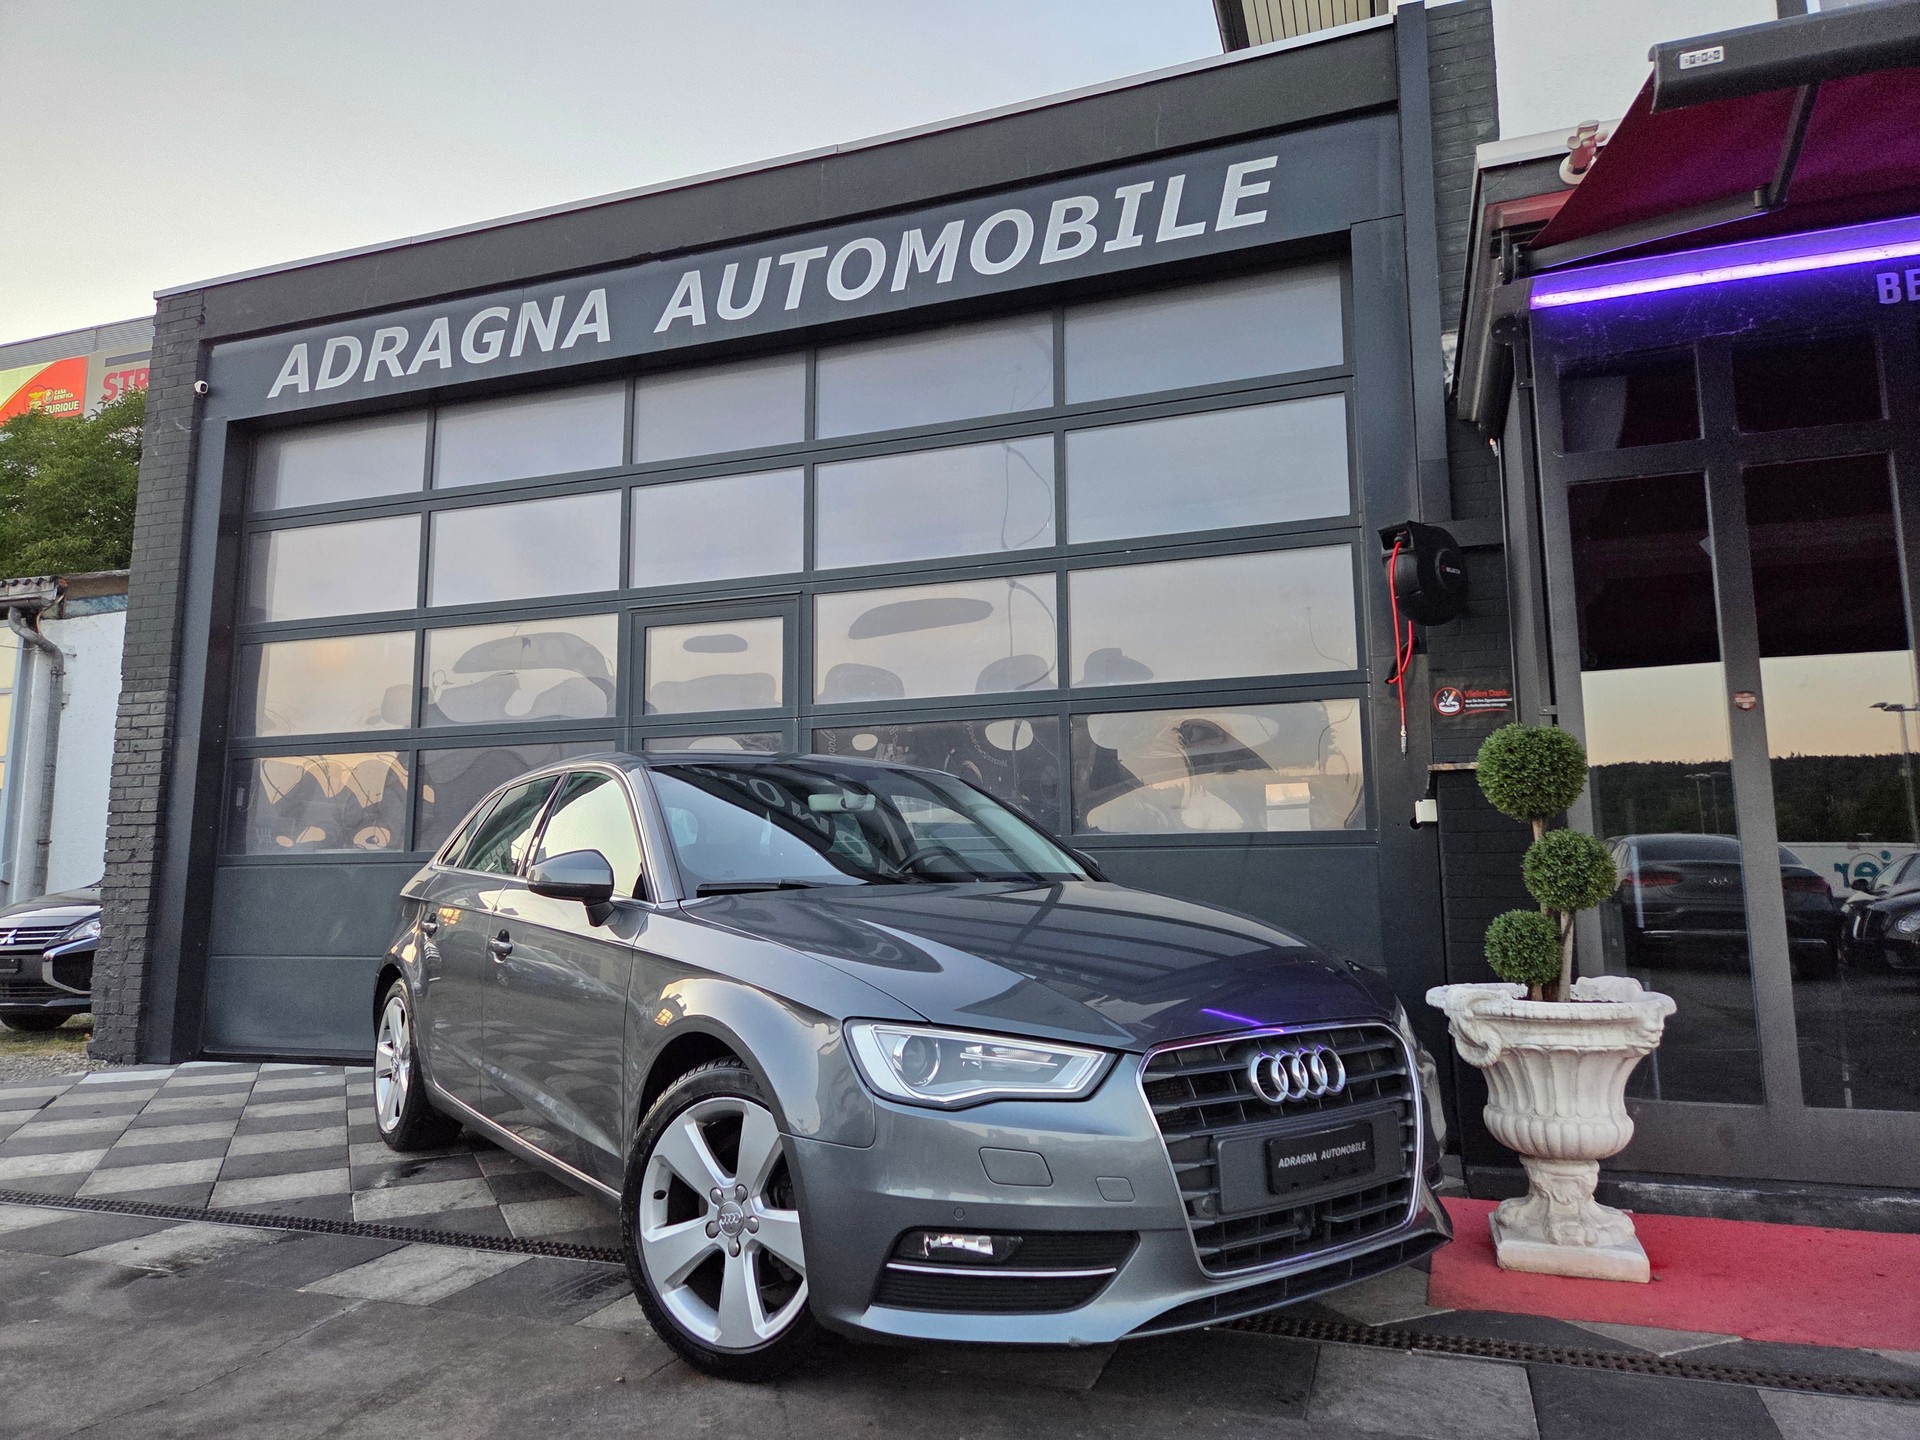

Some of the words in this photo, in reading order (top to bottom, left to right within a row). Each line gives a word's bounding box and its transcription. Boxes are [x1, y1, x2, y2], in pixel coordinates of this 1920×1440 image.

[267, 288, 610, 398] ADRAGNA
[653, 156, 1278, 333] AUTOMOBILE
[1876, 268, 1920, 305] BE
[44, 400, 80, 414] ZURIQUE
[1278, 1152, 1318, 1169] ADRAGNA
[1320, 1141, 1367, 1161] AUTOMOBILE
